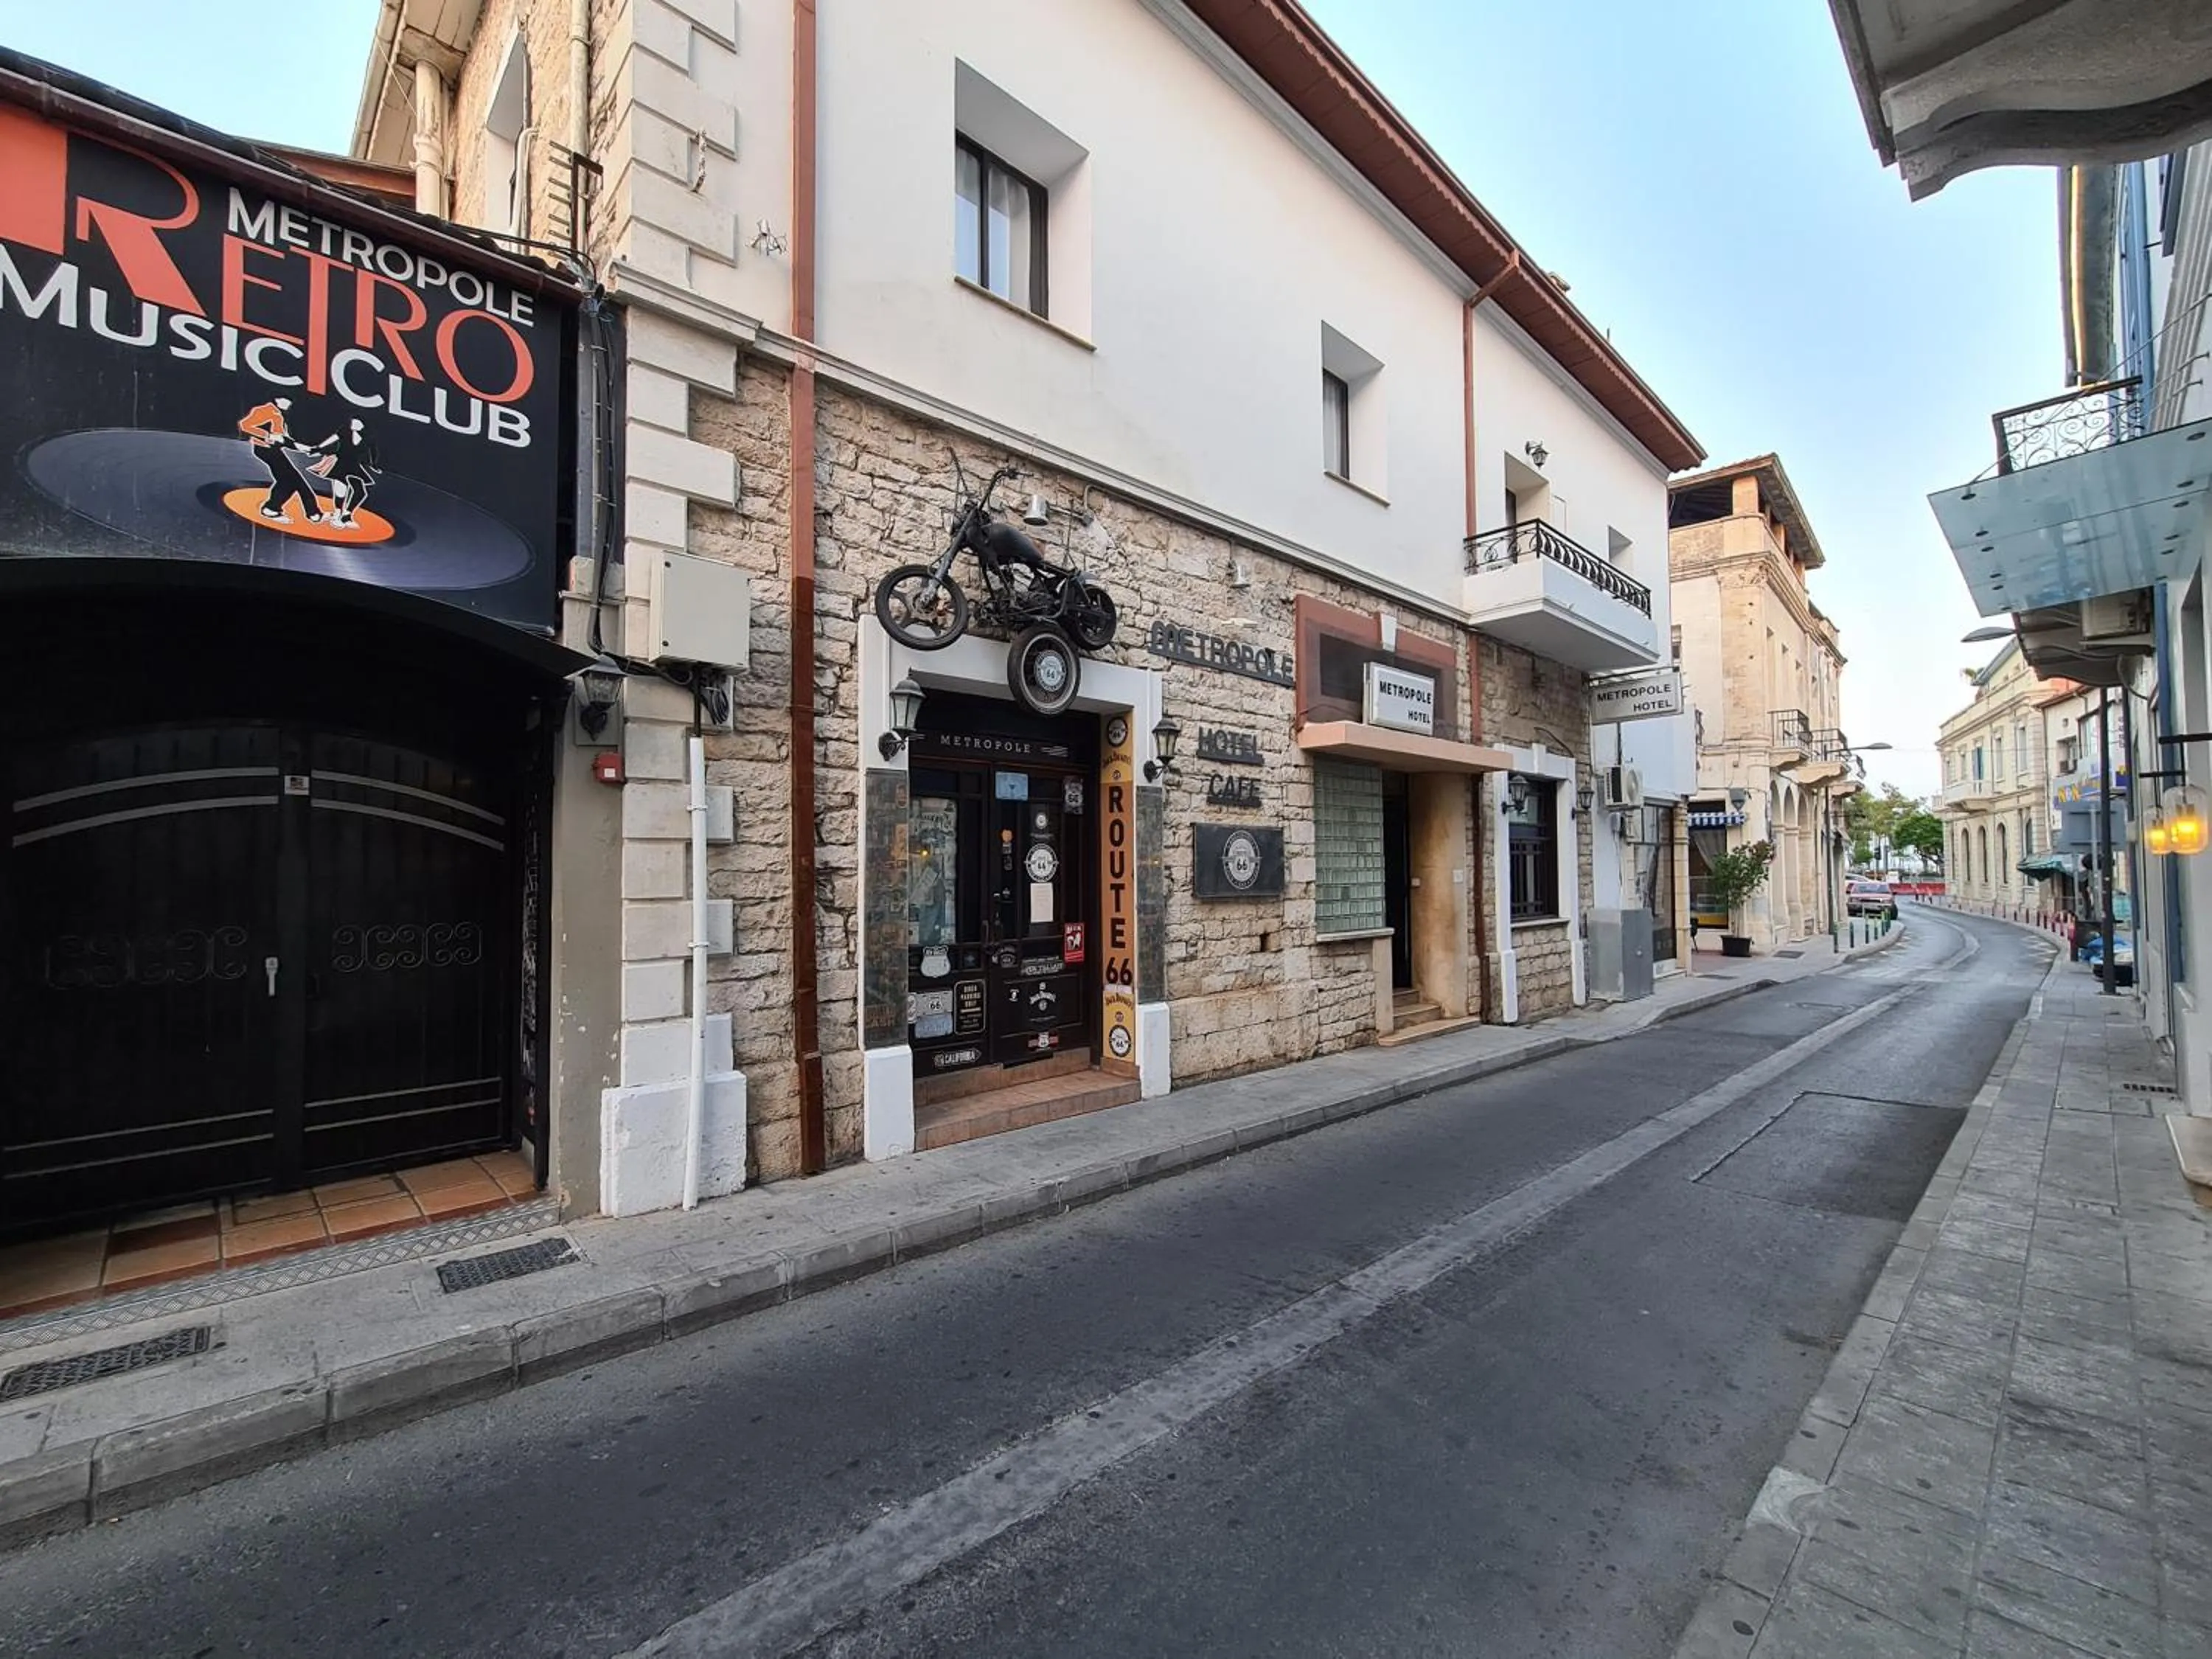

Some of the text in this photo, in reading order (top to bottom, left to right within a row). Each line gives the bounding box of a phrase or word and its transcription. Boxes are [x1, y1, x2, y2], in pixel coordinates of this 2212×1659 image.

[0, 103, 535, 403] RETRO
[228, 187, 535, 328] METROPOLE
[0, 242, 532, 448] MUSIC CLUB
[1147, 620, 1295, 689] METROPOLE
[1380, 681, 1432, 705] METROPOLE
[1596, 684, 1672, 702] METROPOLE
[1632, 699, 1673, 712] HOTEL
[1408, 710, 1430, 723] HOTEL
[940, 734, 1032, 754] METROPOLE
[1196, 726, 1265, 766] HOTEL
[1206, 774, 1262, 807] CAFE
[1108, 785, 1126, 948] ROUTE
[1237, 858, 1248, 871] 66
[1106, 957, 1133, 985] 66
[930, 1002, 941, 1010] 66
